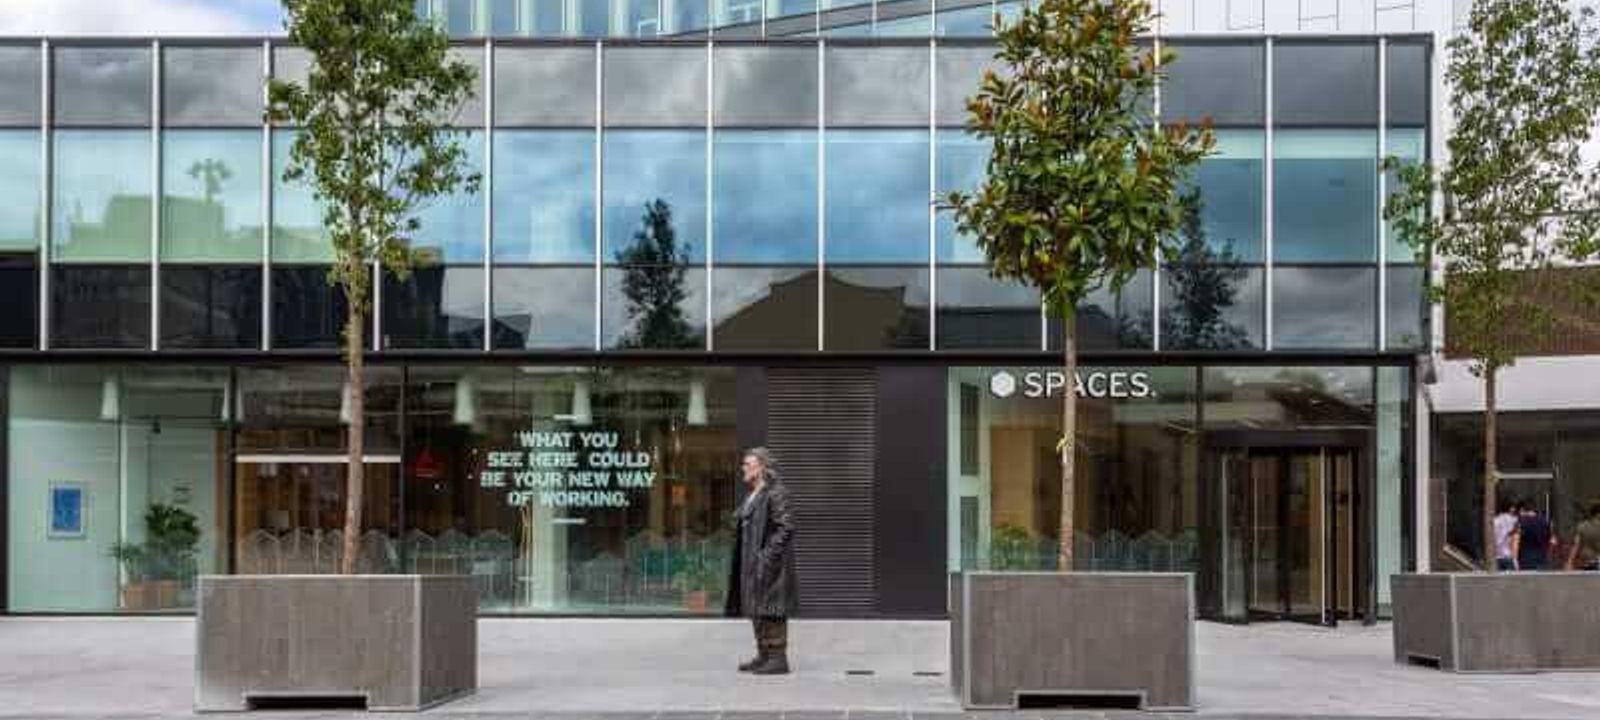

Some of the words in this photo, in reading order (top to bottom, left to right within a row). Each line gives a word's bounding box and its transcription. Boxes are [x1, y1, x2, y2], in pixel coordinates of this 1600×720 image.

[519, 431, 575, 448] WHAT
[580, 431, 618, 448] YOU
[487, 451, 524, 467] SEE
[529, 451, 579, 467] HERE
[589, 451, 650, 467] COULD
[480, 471, 507, 487] BE
[513, 471, 564, 487] YOUR
[568, 471, 612, 487] NEW
[616, 471, 657, 487] WAY
[508, 491, 533, 506] OF
[541, 491, 630, 507] WORKING.
